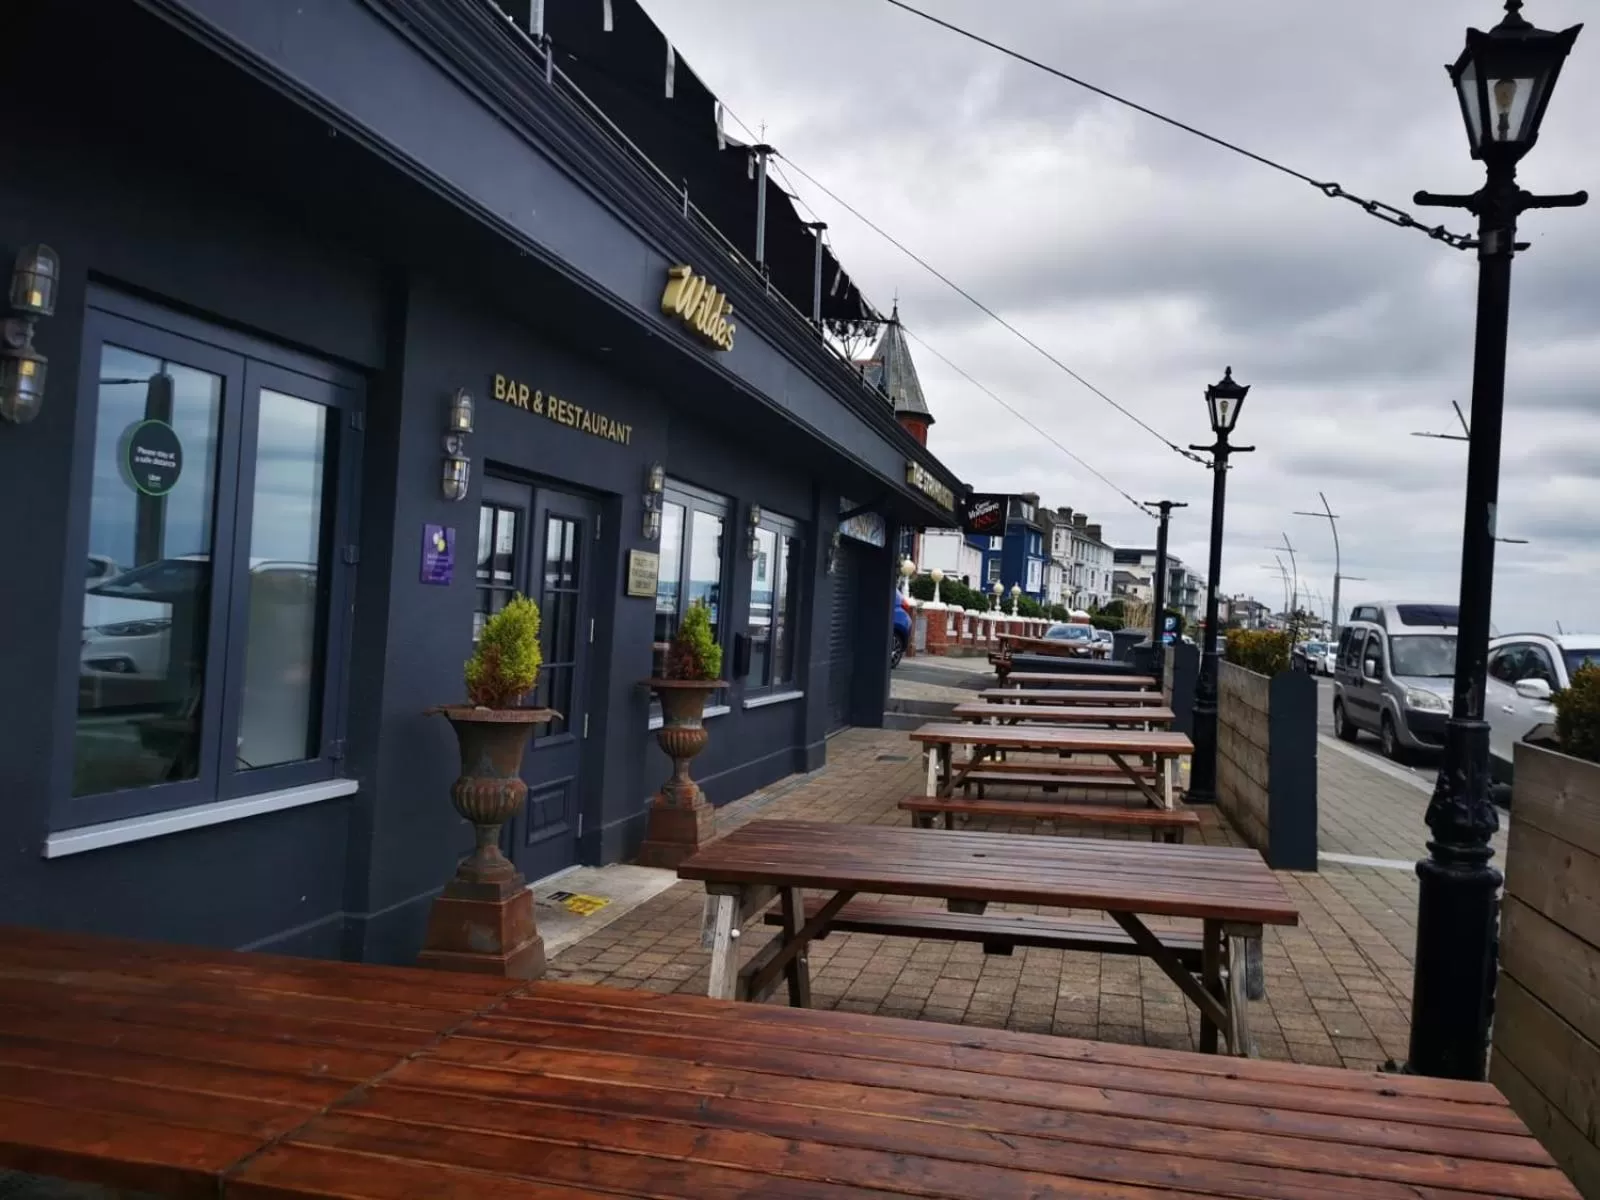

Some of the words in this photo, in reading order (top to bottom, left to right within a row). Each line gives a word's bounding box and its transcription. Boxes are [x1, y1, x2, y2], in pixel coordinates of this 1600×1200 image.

[670, 265, 736, 351] Wilde's
[495, 373, 530, 410] BAR
[533, 390, 544, 414] &
[548, 396, 632, 445] RESTAURANT
[152, 458, 176, 468] distance
